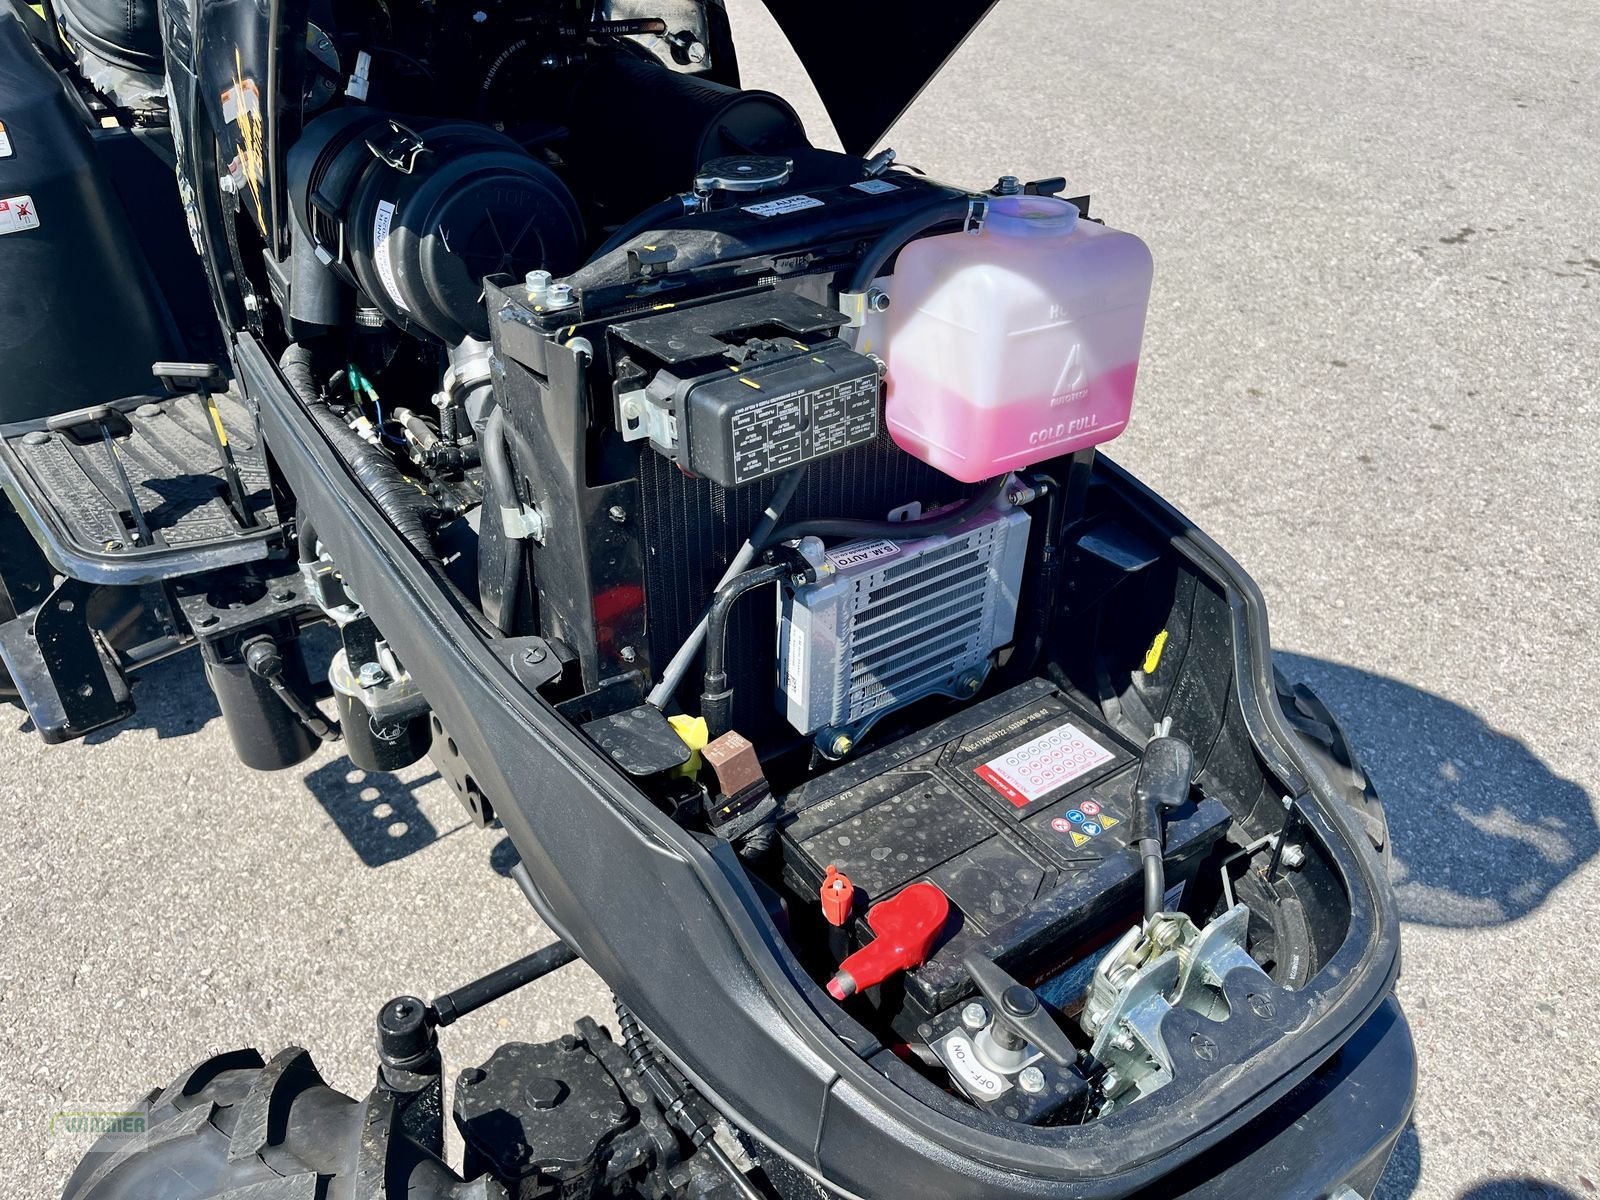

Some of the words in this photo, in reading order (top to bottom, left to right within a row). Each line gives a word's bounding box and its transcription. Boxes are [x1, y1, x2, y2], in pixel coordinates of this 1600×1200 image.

[1029, 424, 1065, 445] COLD
[1068, 414, 1099, 434] FULL
[838, 554, 869, 566] AUTO
[953, 1044, 966, 1060] ON
[973, 1073, 995, 1090] OFF
